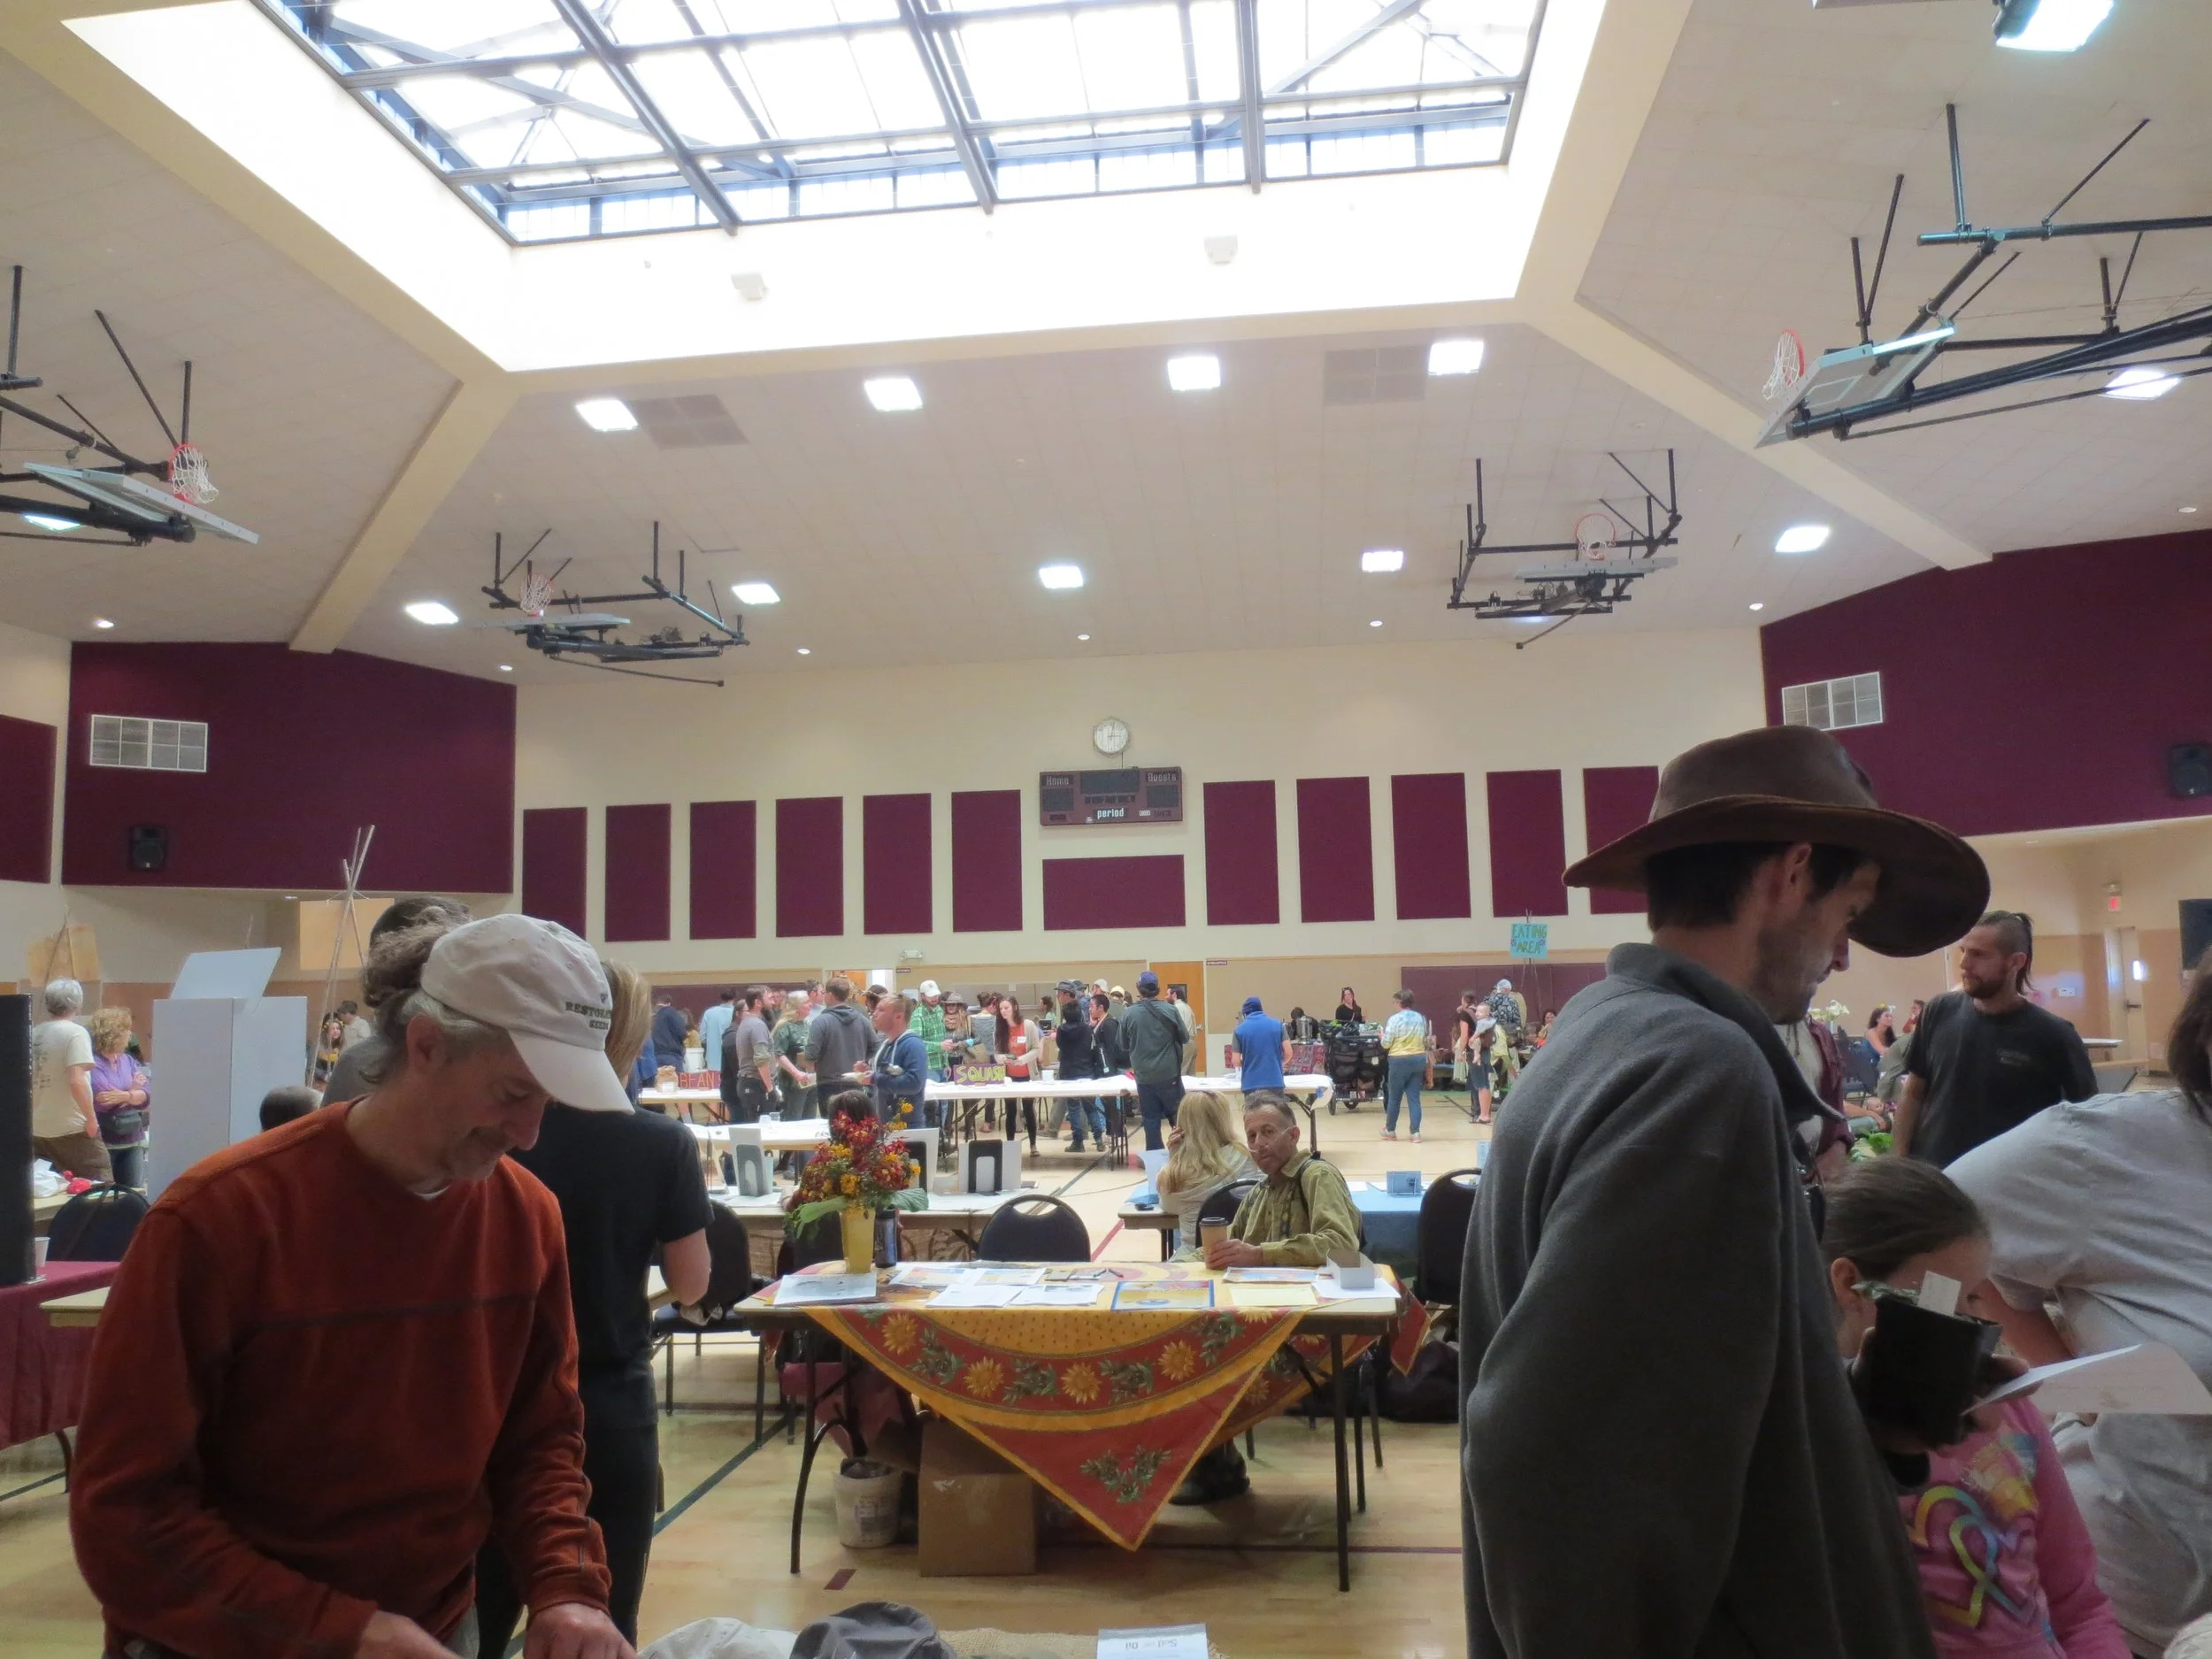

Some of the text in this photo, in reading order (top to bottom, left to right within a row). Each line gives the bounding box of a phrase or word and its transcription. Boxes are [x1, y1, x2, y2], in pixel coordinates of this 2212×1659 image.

[1046, 775, 1069, 786] Home
[1148, 772, 1177, 782] Guests
[1097, 808, 1125, 819] period
[1511, 924, 1548, 939] EATING
[1516, 941, 1541, 954] AREA
[956, 1065, 1006, 1083] SQUASH
